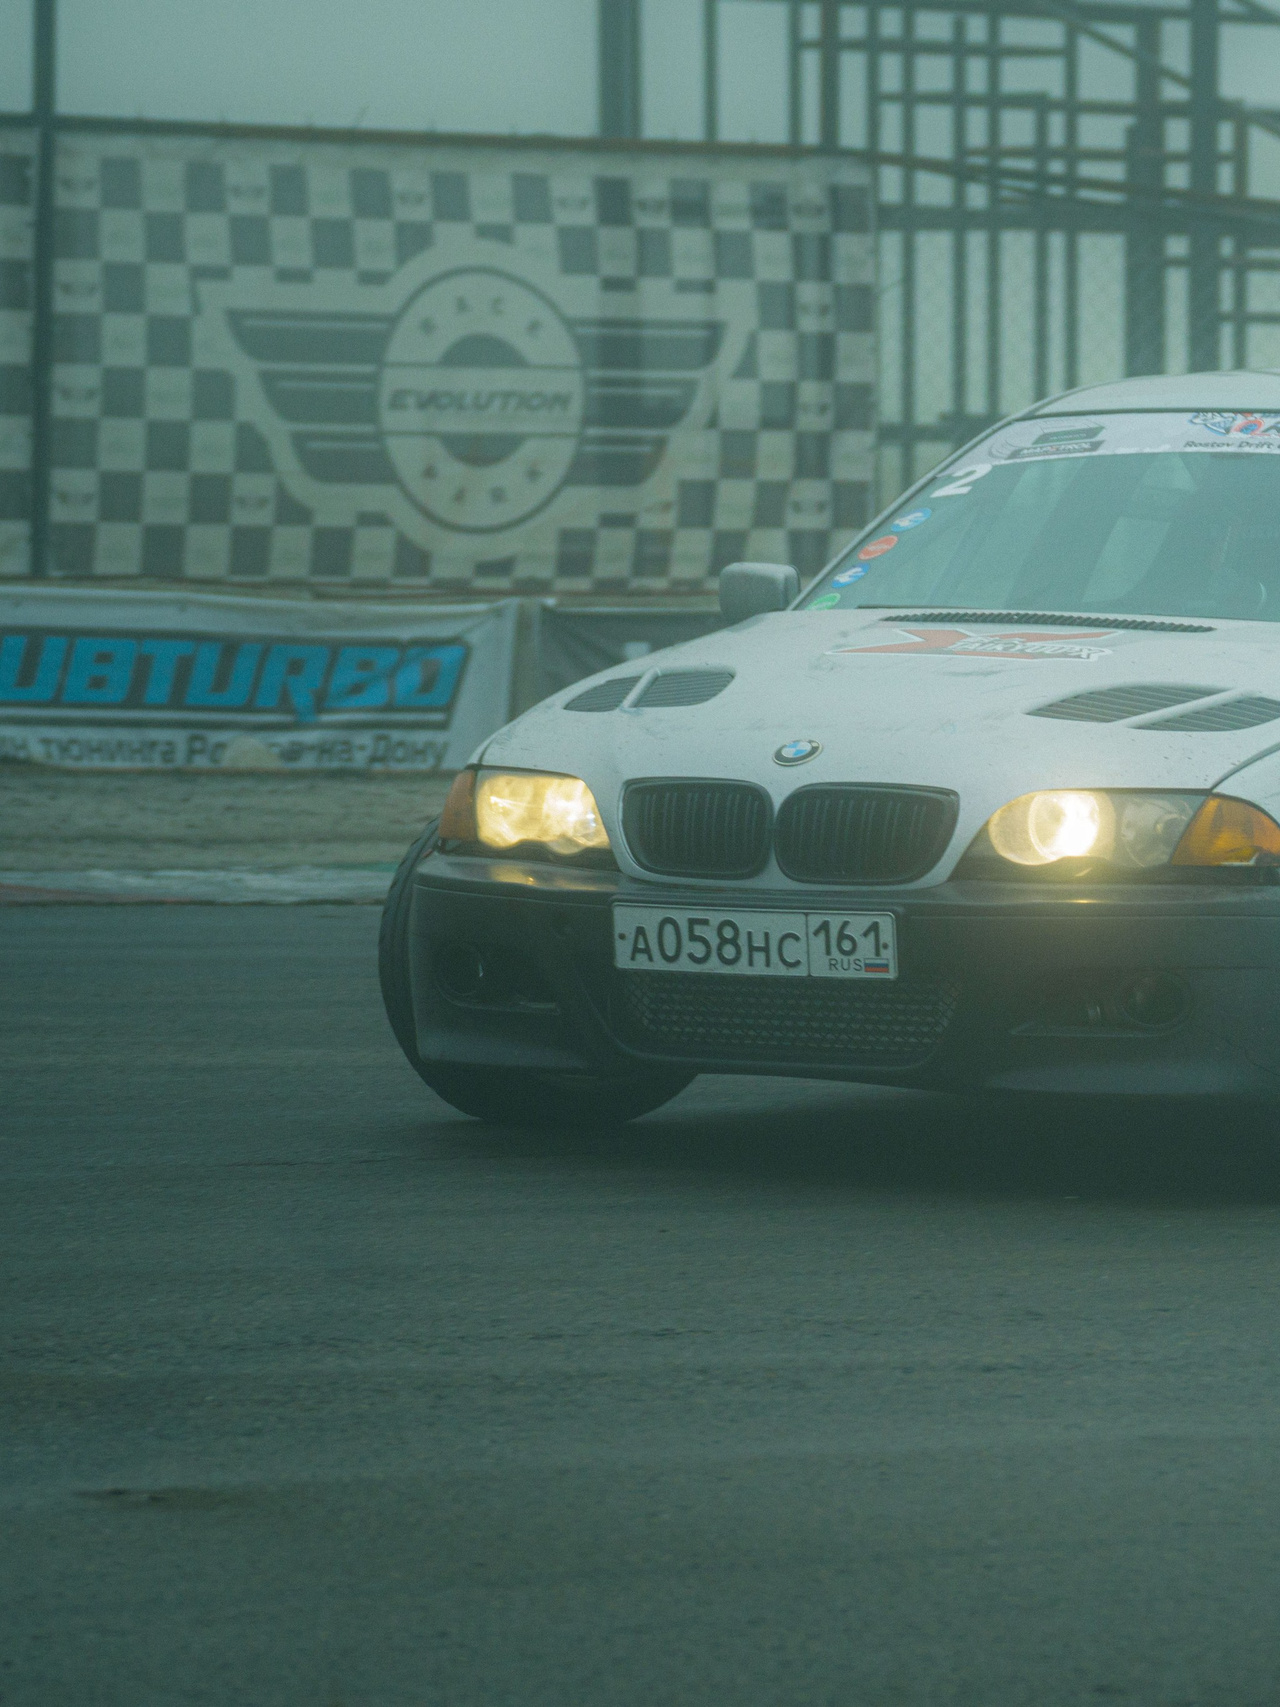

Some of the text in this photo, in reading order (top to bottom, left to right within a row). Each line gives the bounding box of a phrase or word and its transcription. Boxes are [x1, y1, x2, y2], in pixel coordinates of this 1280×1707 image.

[388, 389, 574, 412] EVOLUTION
[1183, 440, 1233, 449] Rostov
[1238, 440, 1273, 449] Drift
[812, 919, 881, 957] 161
[828, 956, 863, 972] RUS
